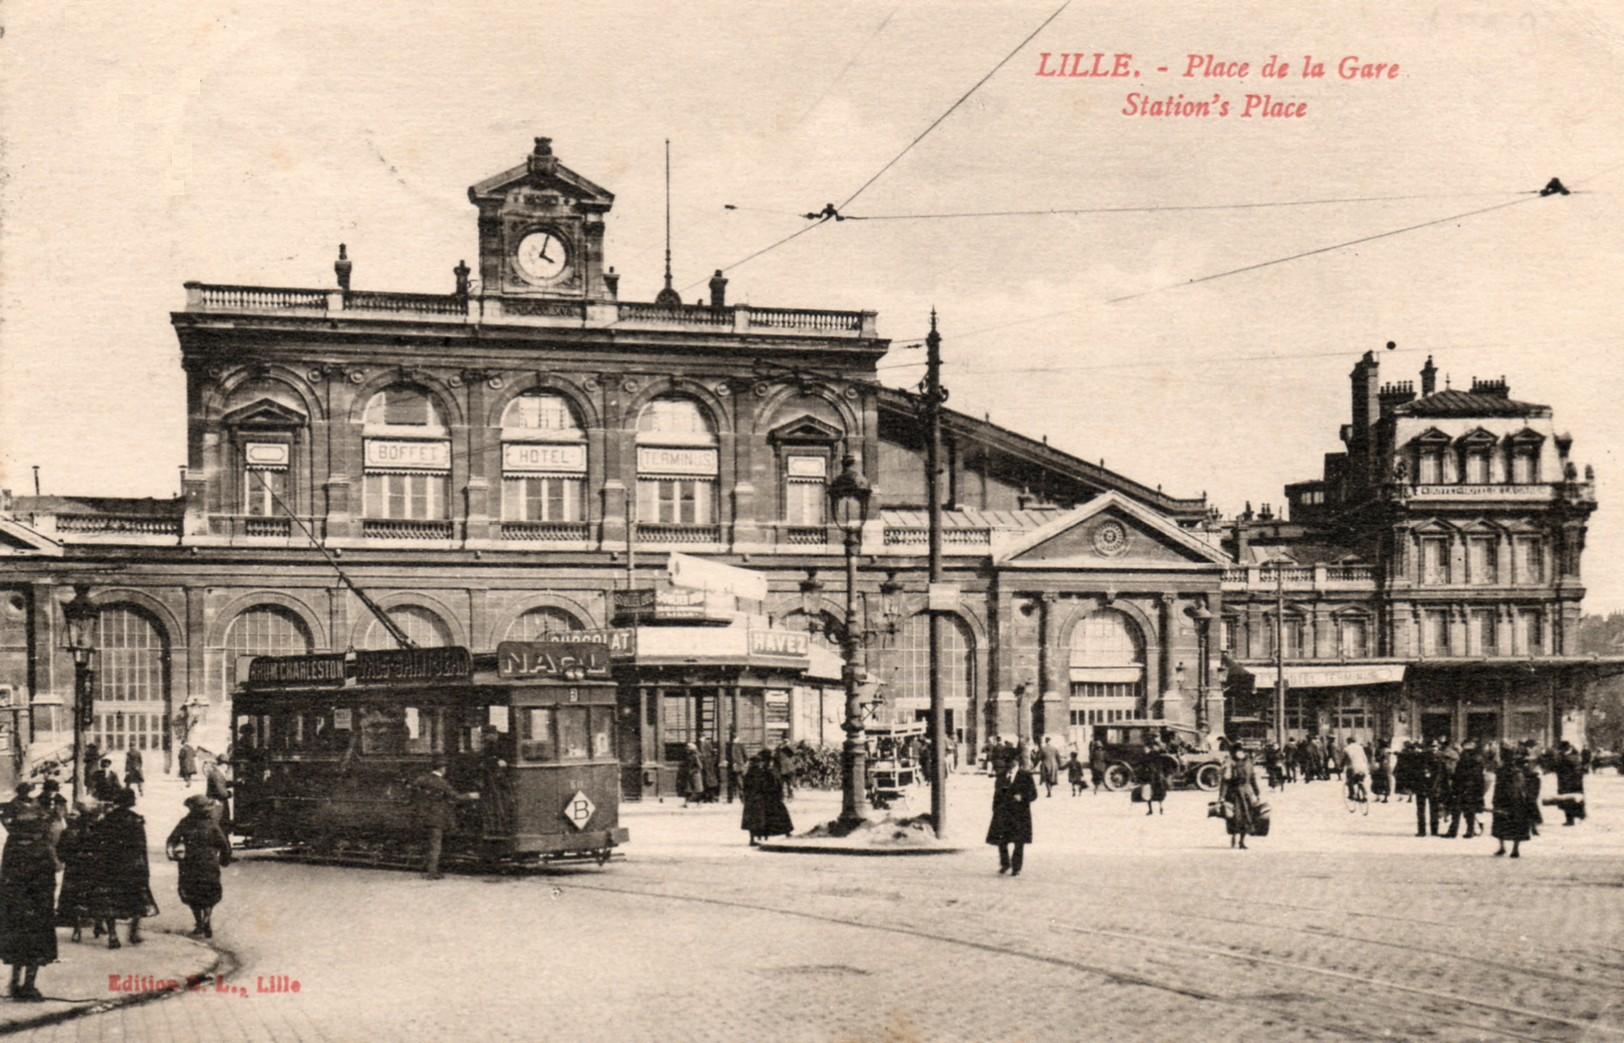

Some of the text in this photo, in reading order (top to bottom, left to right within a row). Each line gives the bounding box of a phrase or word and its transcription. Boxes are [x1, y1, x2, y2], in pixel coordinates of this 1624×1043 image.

[519, 448, 569, 464] HOTEL
[753, 633, 806, 655] HAVEZ
[279, 659, 344, 681] CHARLESTON
[574, 800, 590, 820] B
